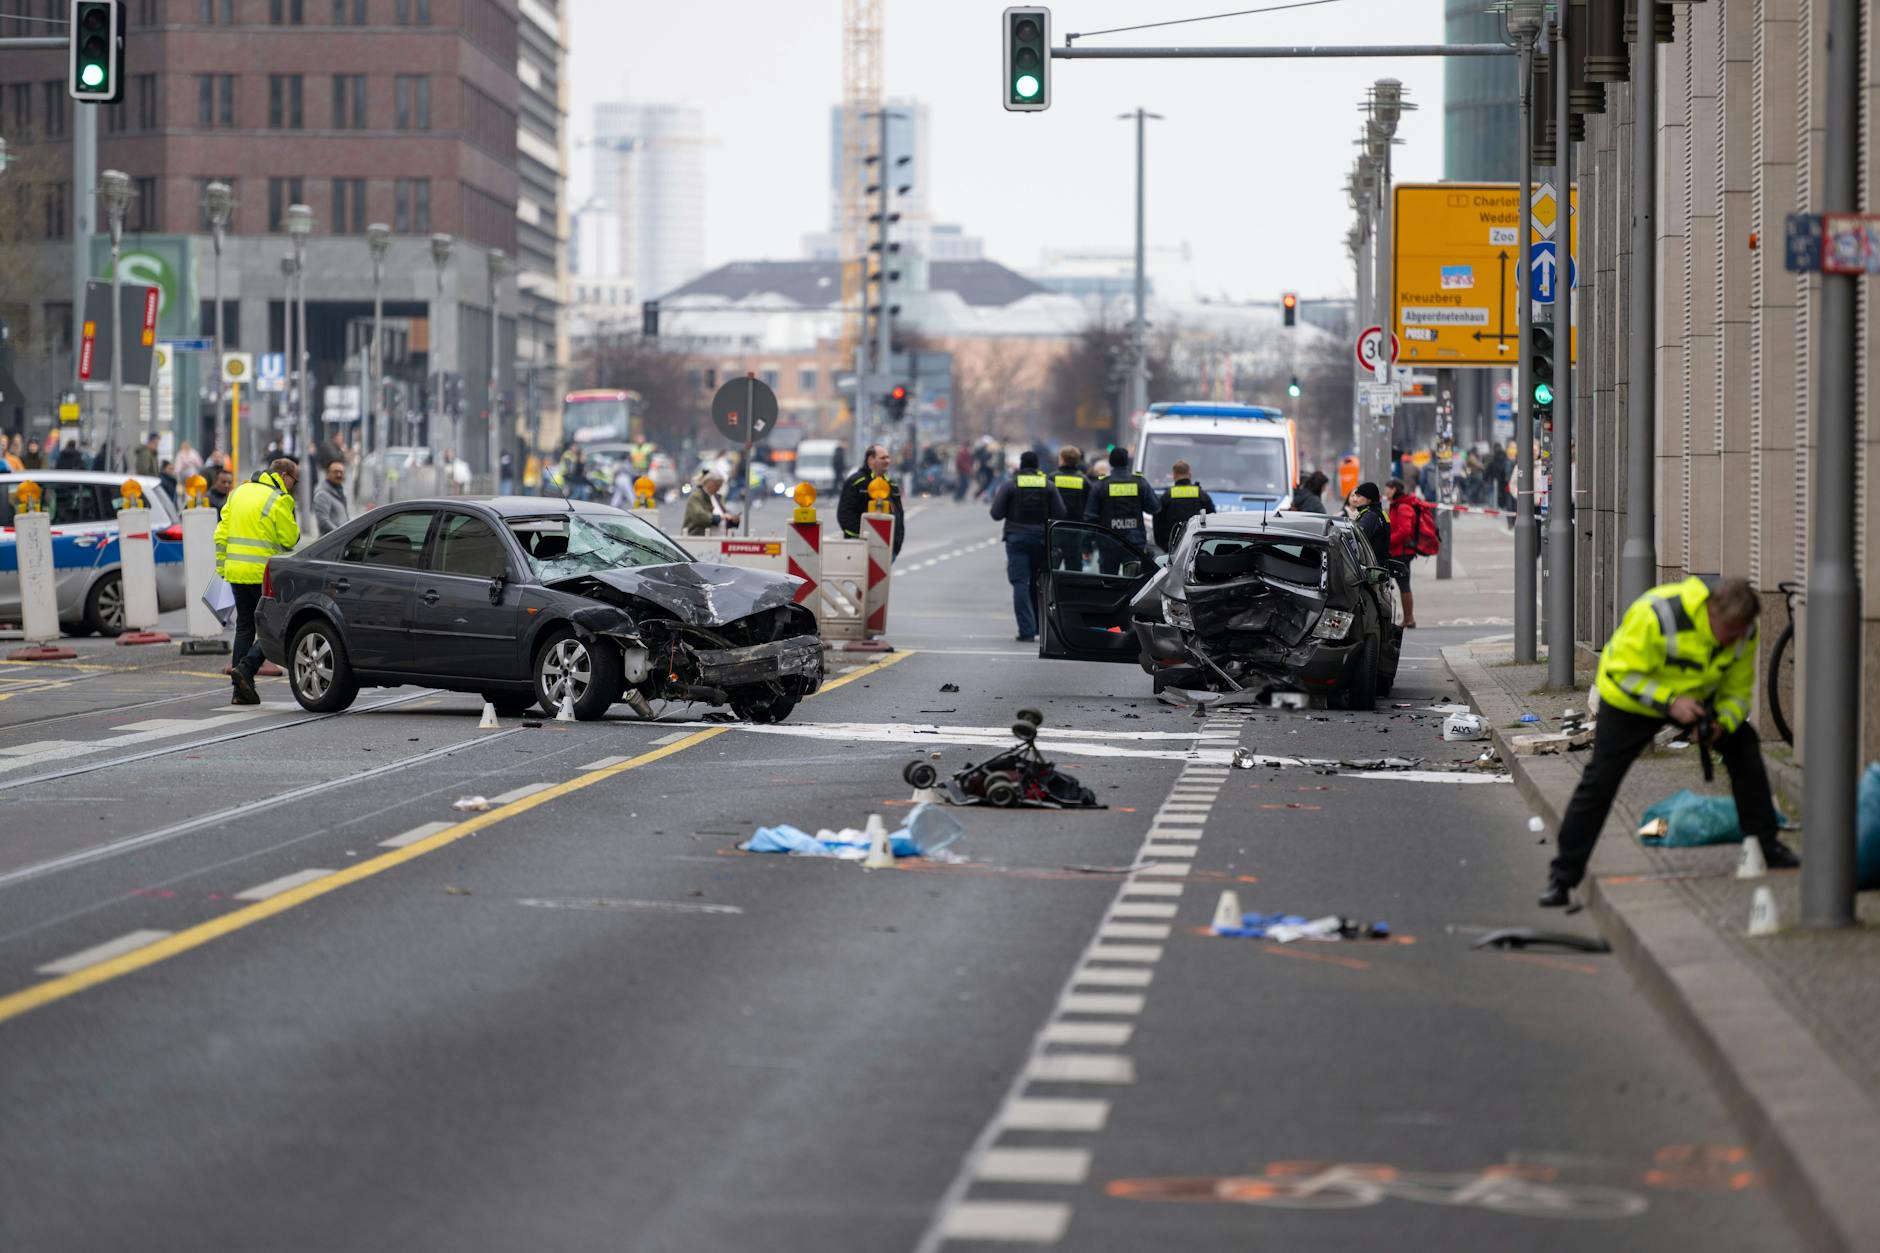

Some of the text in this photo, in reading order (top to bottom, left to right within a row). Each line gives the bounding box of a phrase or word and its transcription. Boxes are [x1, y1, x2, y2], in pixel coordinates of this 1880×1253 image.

[1493, 231, 1514, 242] Zoo
[1400, 293, 1462, 305] Kreuzberg
[1405, 311, 1485, 322] Abgeordnetenhaus
[1365, 339, 1382, 359] 3
[261, 353, 282, 378] U
[1111, 518, 1137, 529] POLIZEI
